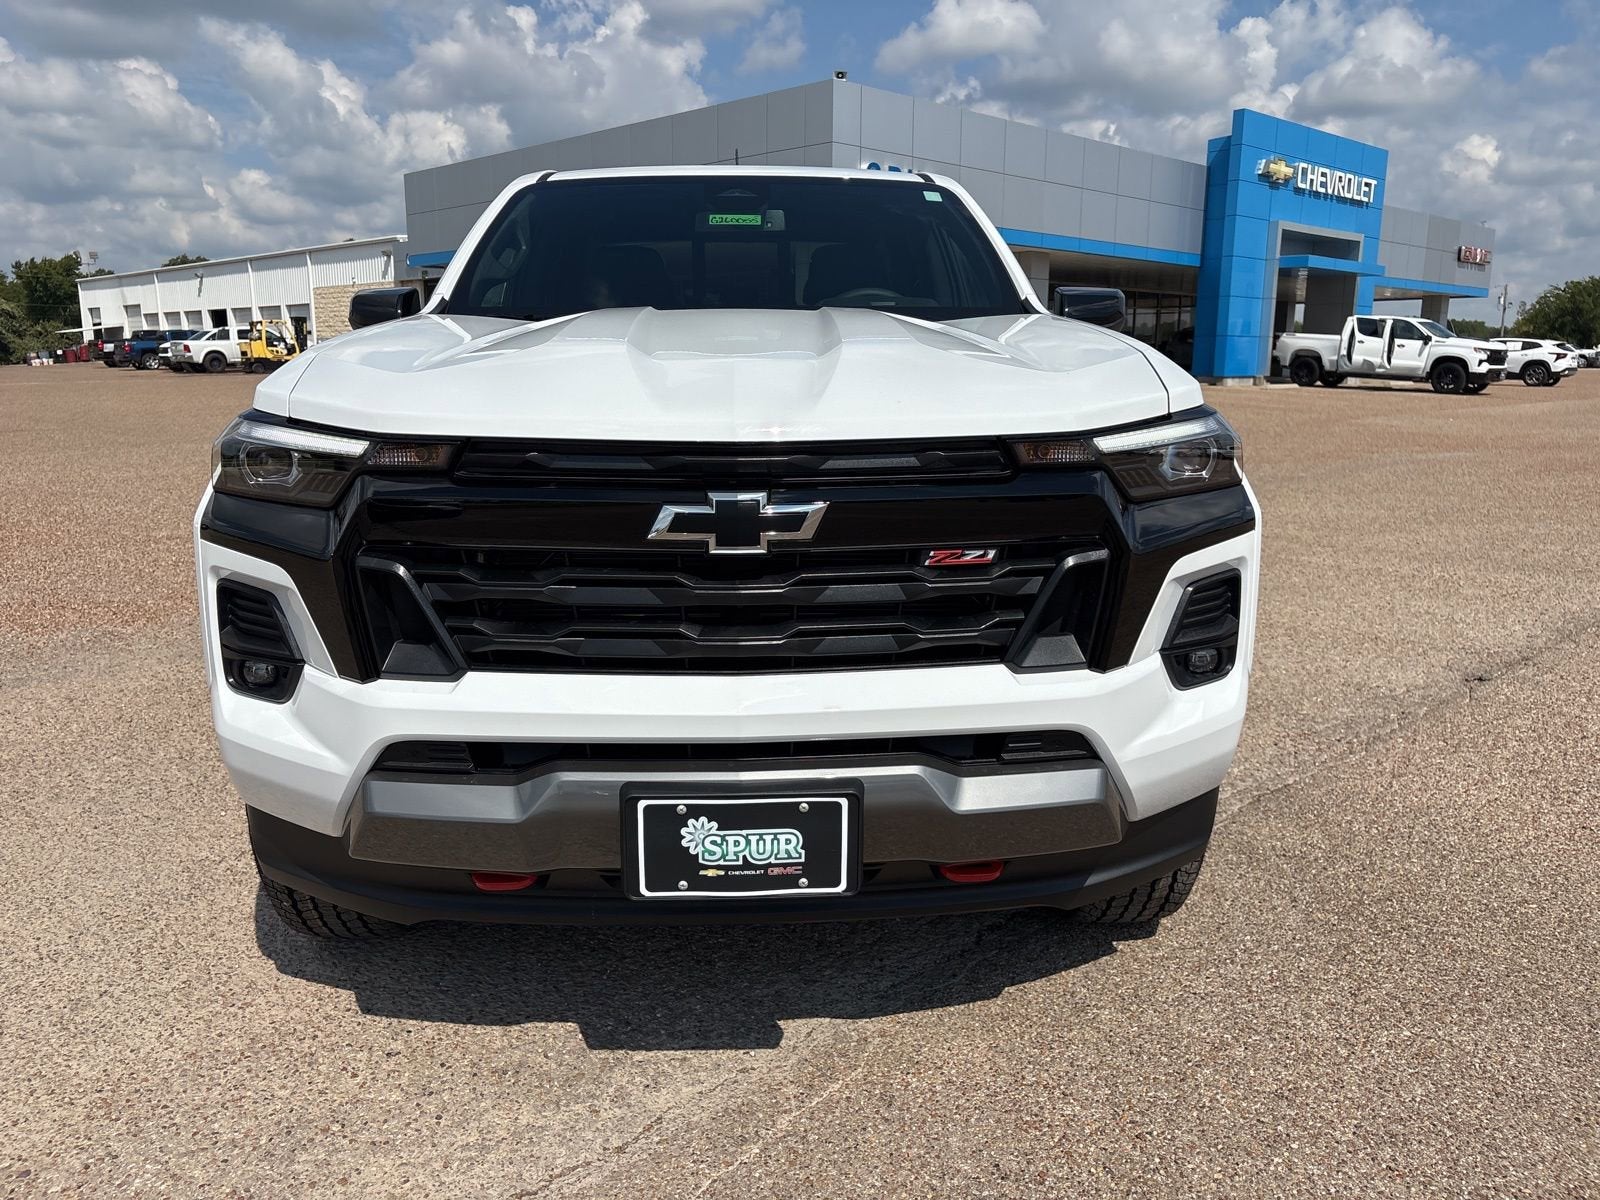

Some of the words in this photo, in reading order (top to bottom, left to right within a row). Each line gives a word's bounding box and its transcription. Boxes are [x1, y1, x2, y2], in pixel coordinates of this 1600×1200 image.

[1297, 162, 1377, 203] CHEVROLET
[924, 549, 998, 566] Z71
[701, 830, 804, 864] SPUR
[767, 866, 803, 876] GMC
